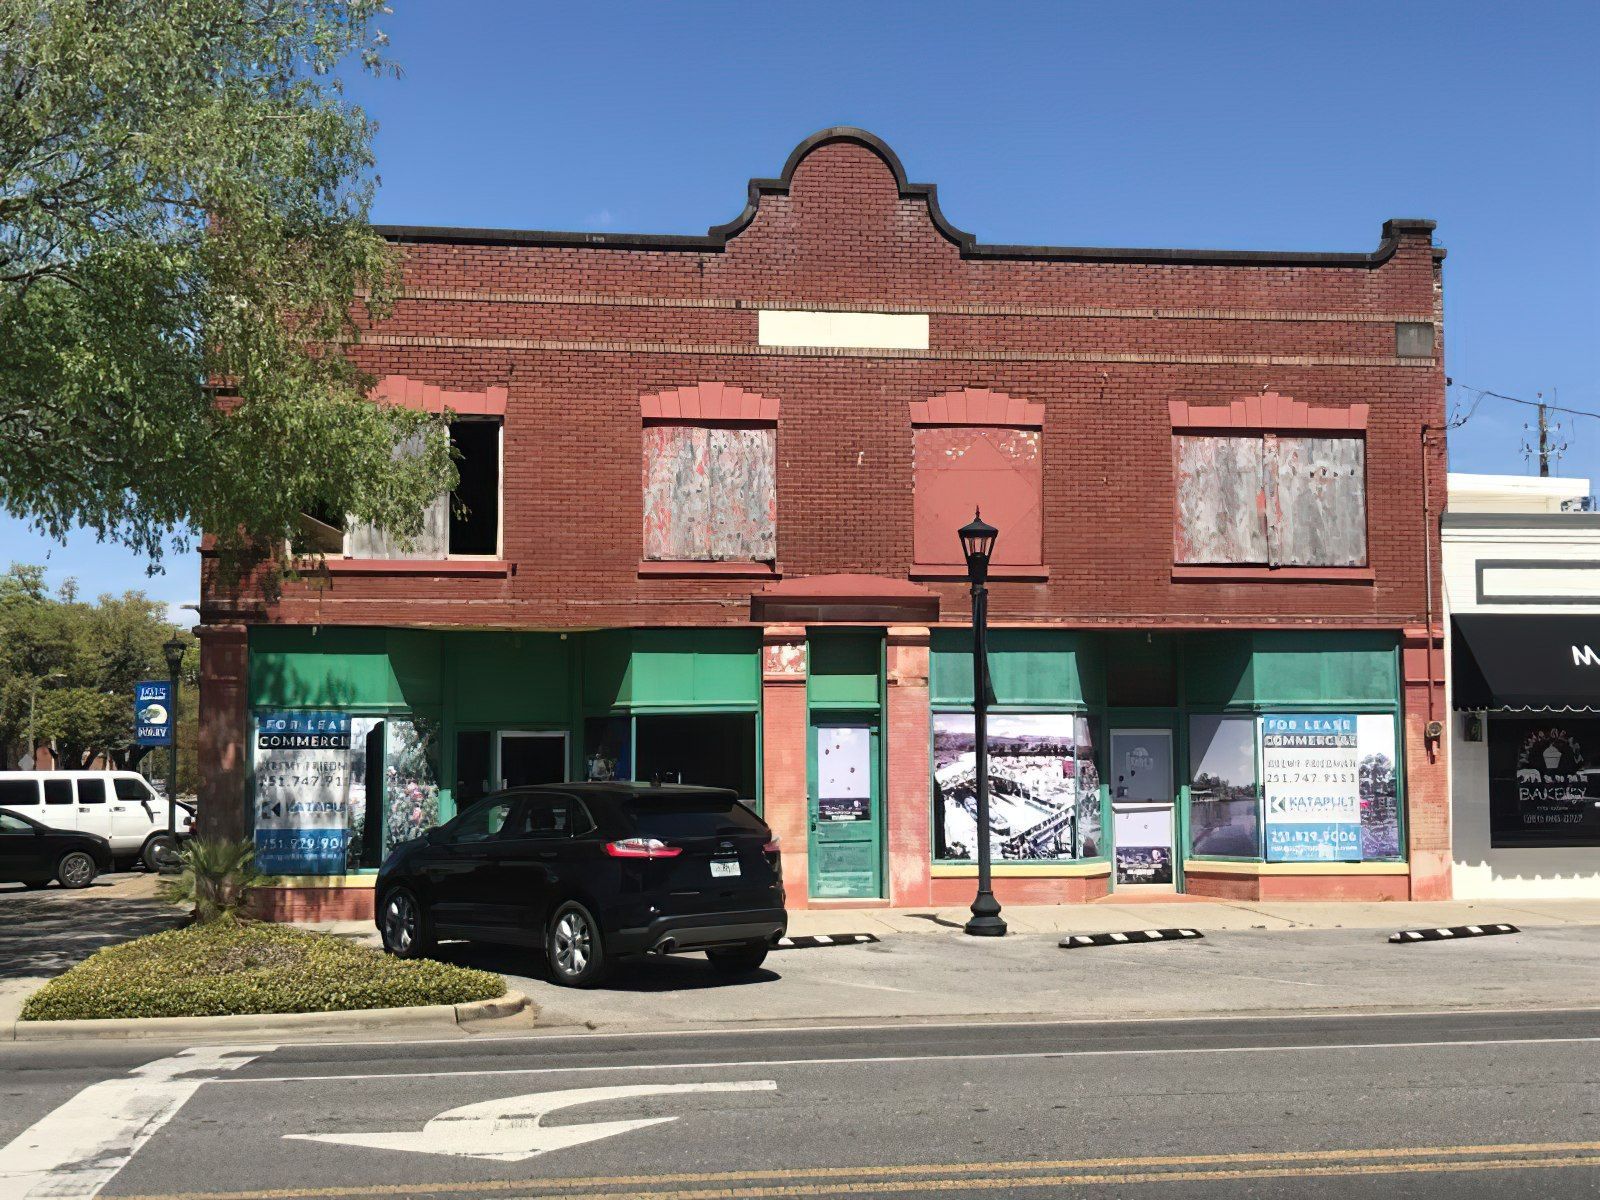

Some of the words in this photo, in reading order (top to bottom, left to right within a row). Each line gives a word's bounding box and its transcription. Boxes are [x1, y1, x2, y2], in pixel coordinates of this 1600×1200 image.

[1269, 719, 1297, 730] FOR
[1304, 719, 1351, 730] LEASE
[1289, 796, 1356, 808] KATAPULT
